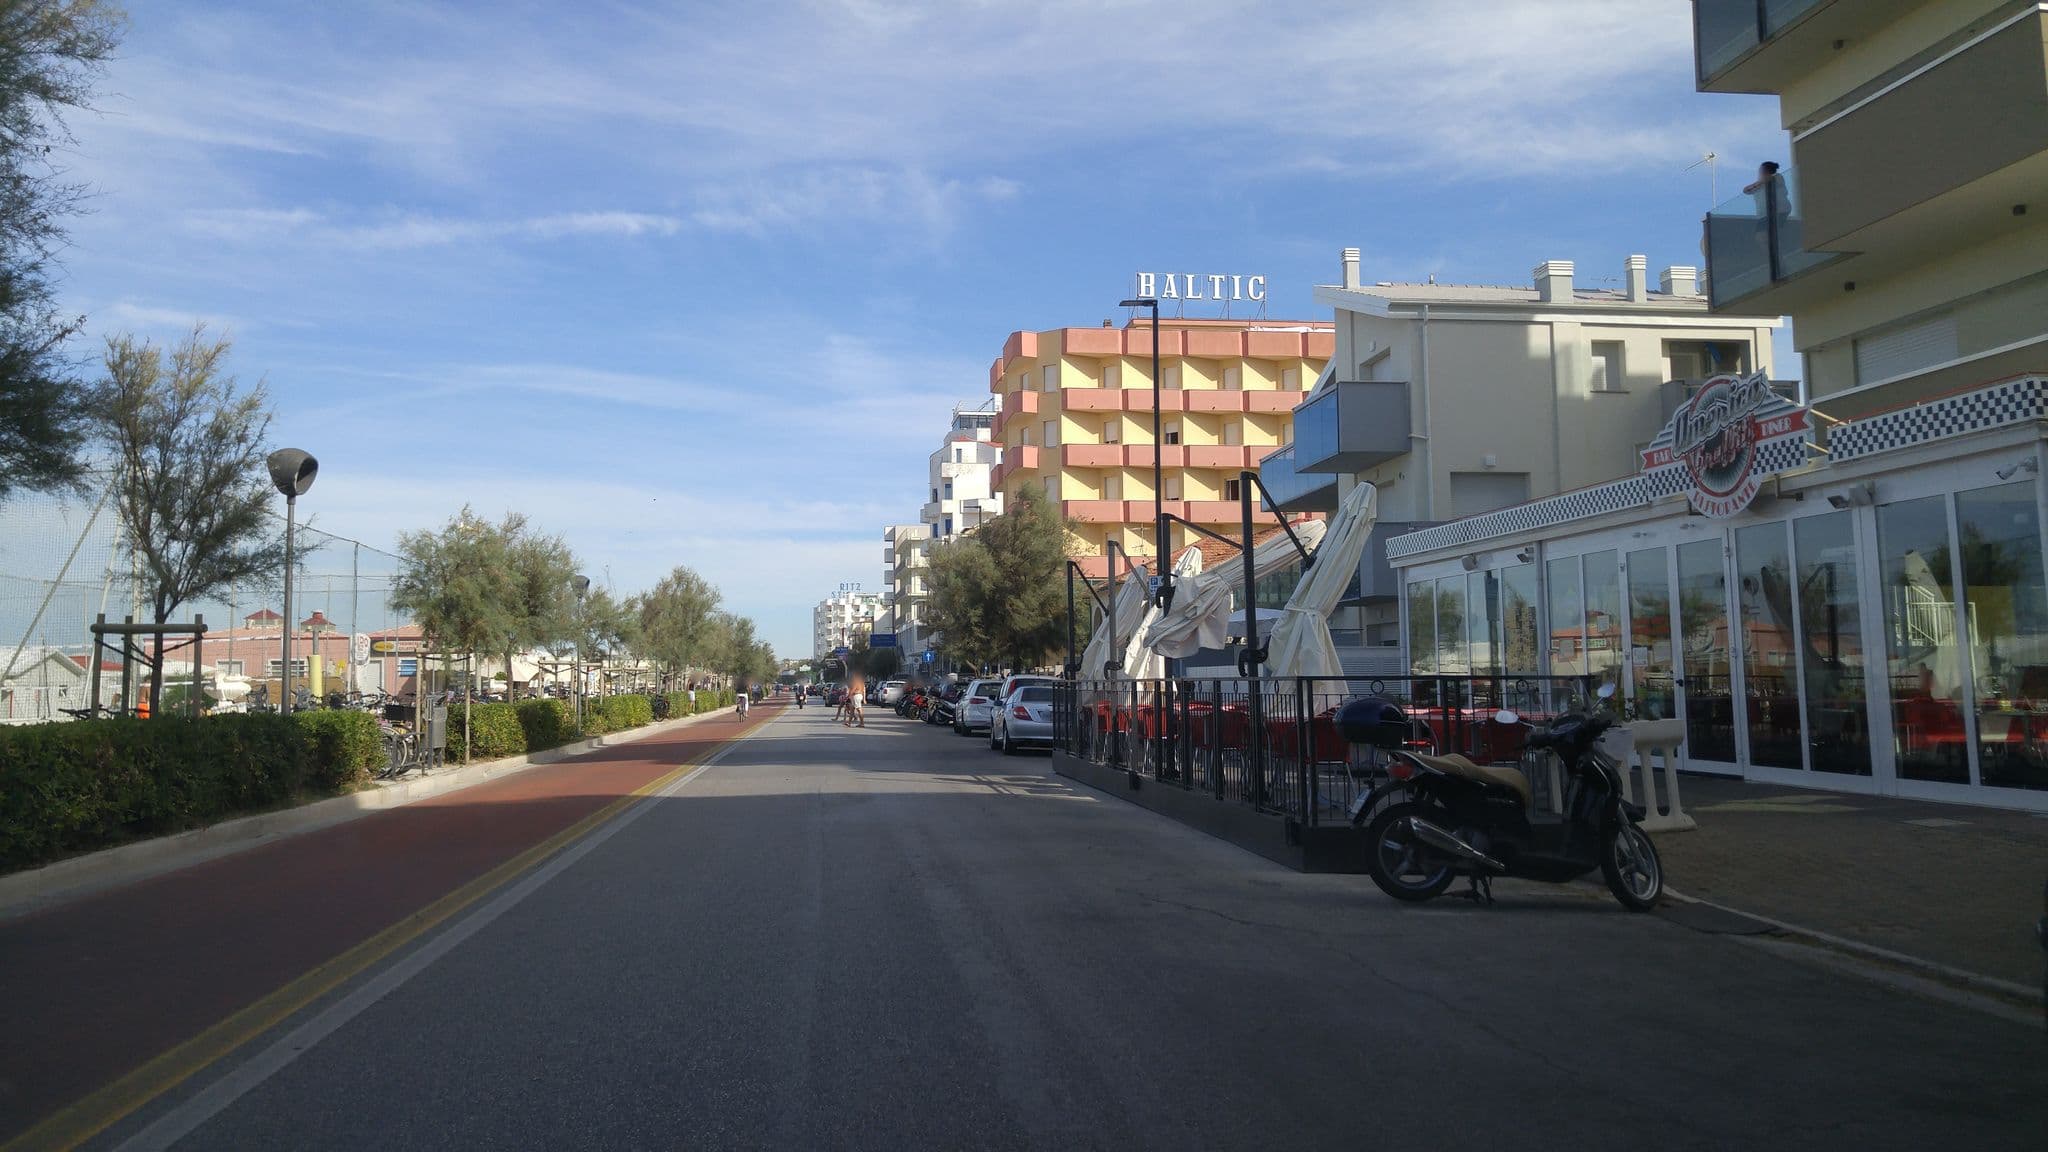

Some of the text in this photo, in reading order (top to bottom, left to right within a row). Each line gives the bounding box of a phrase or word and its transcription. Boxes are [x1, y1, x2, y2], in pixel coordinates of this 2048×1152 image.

[1138, 272, 1265, 300] BALTIC
[1761, 417, 1791, 436] DINER
[1653, 450, 1670, 464] BAR
[839, 583, 861, 591] RITZ
